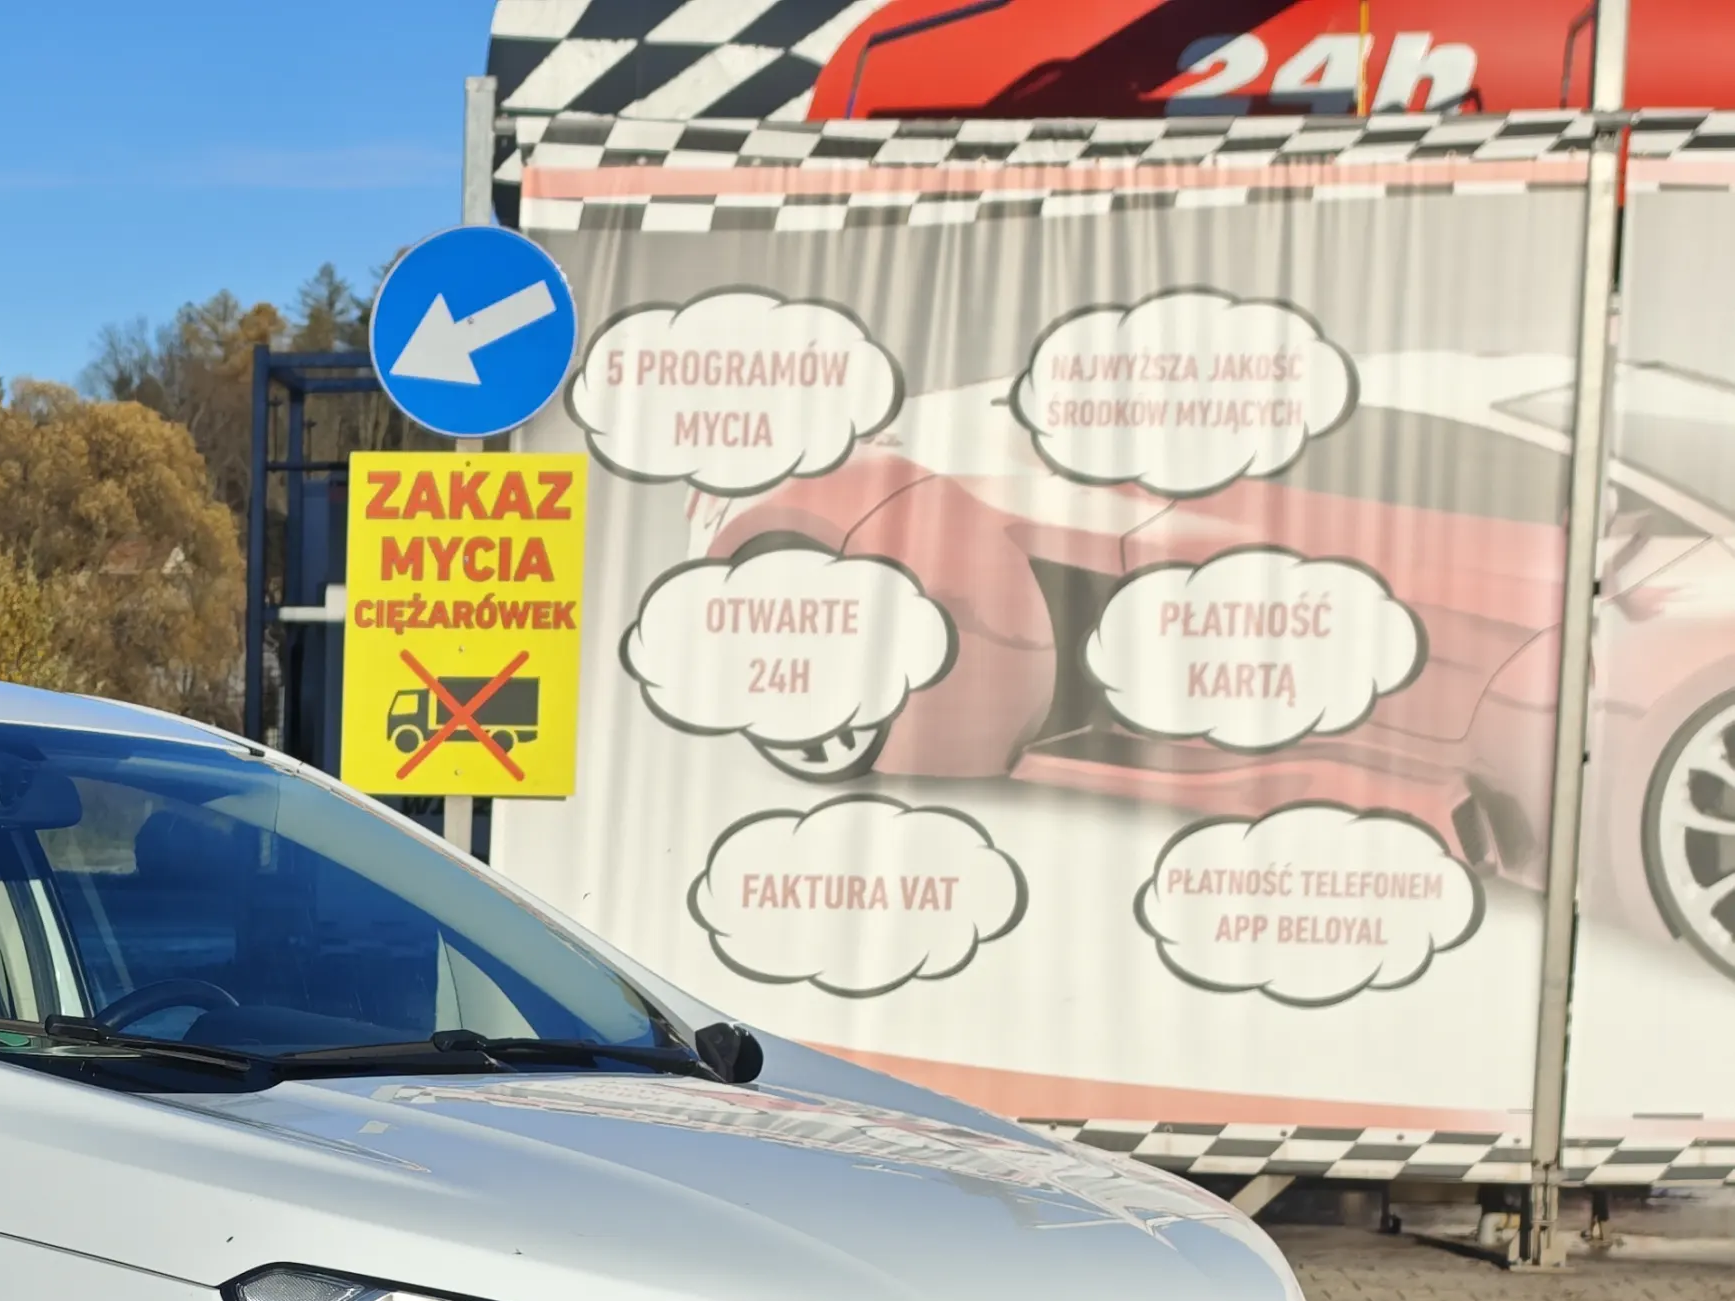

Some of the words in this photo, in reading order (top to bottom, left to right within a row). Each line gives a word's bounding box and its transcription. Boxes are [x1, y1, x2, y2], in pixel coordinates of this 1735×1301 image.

[1164, 31, 1477, 116] 24h
[606, 351, 625, 386] 5
[635, 340, 850, 388] PROGRAMÓW
[1051, 347, 1199, 382] NAJWYŻSZA
[1206, 346, 1304, 382] JAKOŚĆ
[673, 411, 773, 448] MYCIA
[1047, 392, 1168, 428] ŚRODKÓW
[1175, 398, 1303, 434] MYJĄCYCH
[365, 470, 573, 521] ZAKAZ
[379, 537, 555, 584] MYCIA
[353, 594, 577, 635] CIĘŻARÓWEK
[705, 598, 859, 636] OTWARTE
[1159, 592, 1332, 639] PŁATNOŚĆ
[748, 659, 811, 694] 24H
[1187, 662, 1297, 708] KARTĄ
[741, 871, 890, 910] FAKTURA
[900, 876, 959, 912] VAT
[1166, 862, 1293, 898] PŁATNOŚĆ
[1300, 869, 1443, 901] TELEFONEM
[1214, 914, 1268, 944] APP
[1276, 916, 1388, 946] BELOYAL
